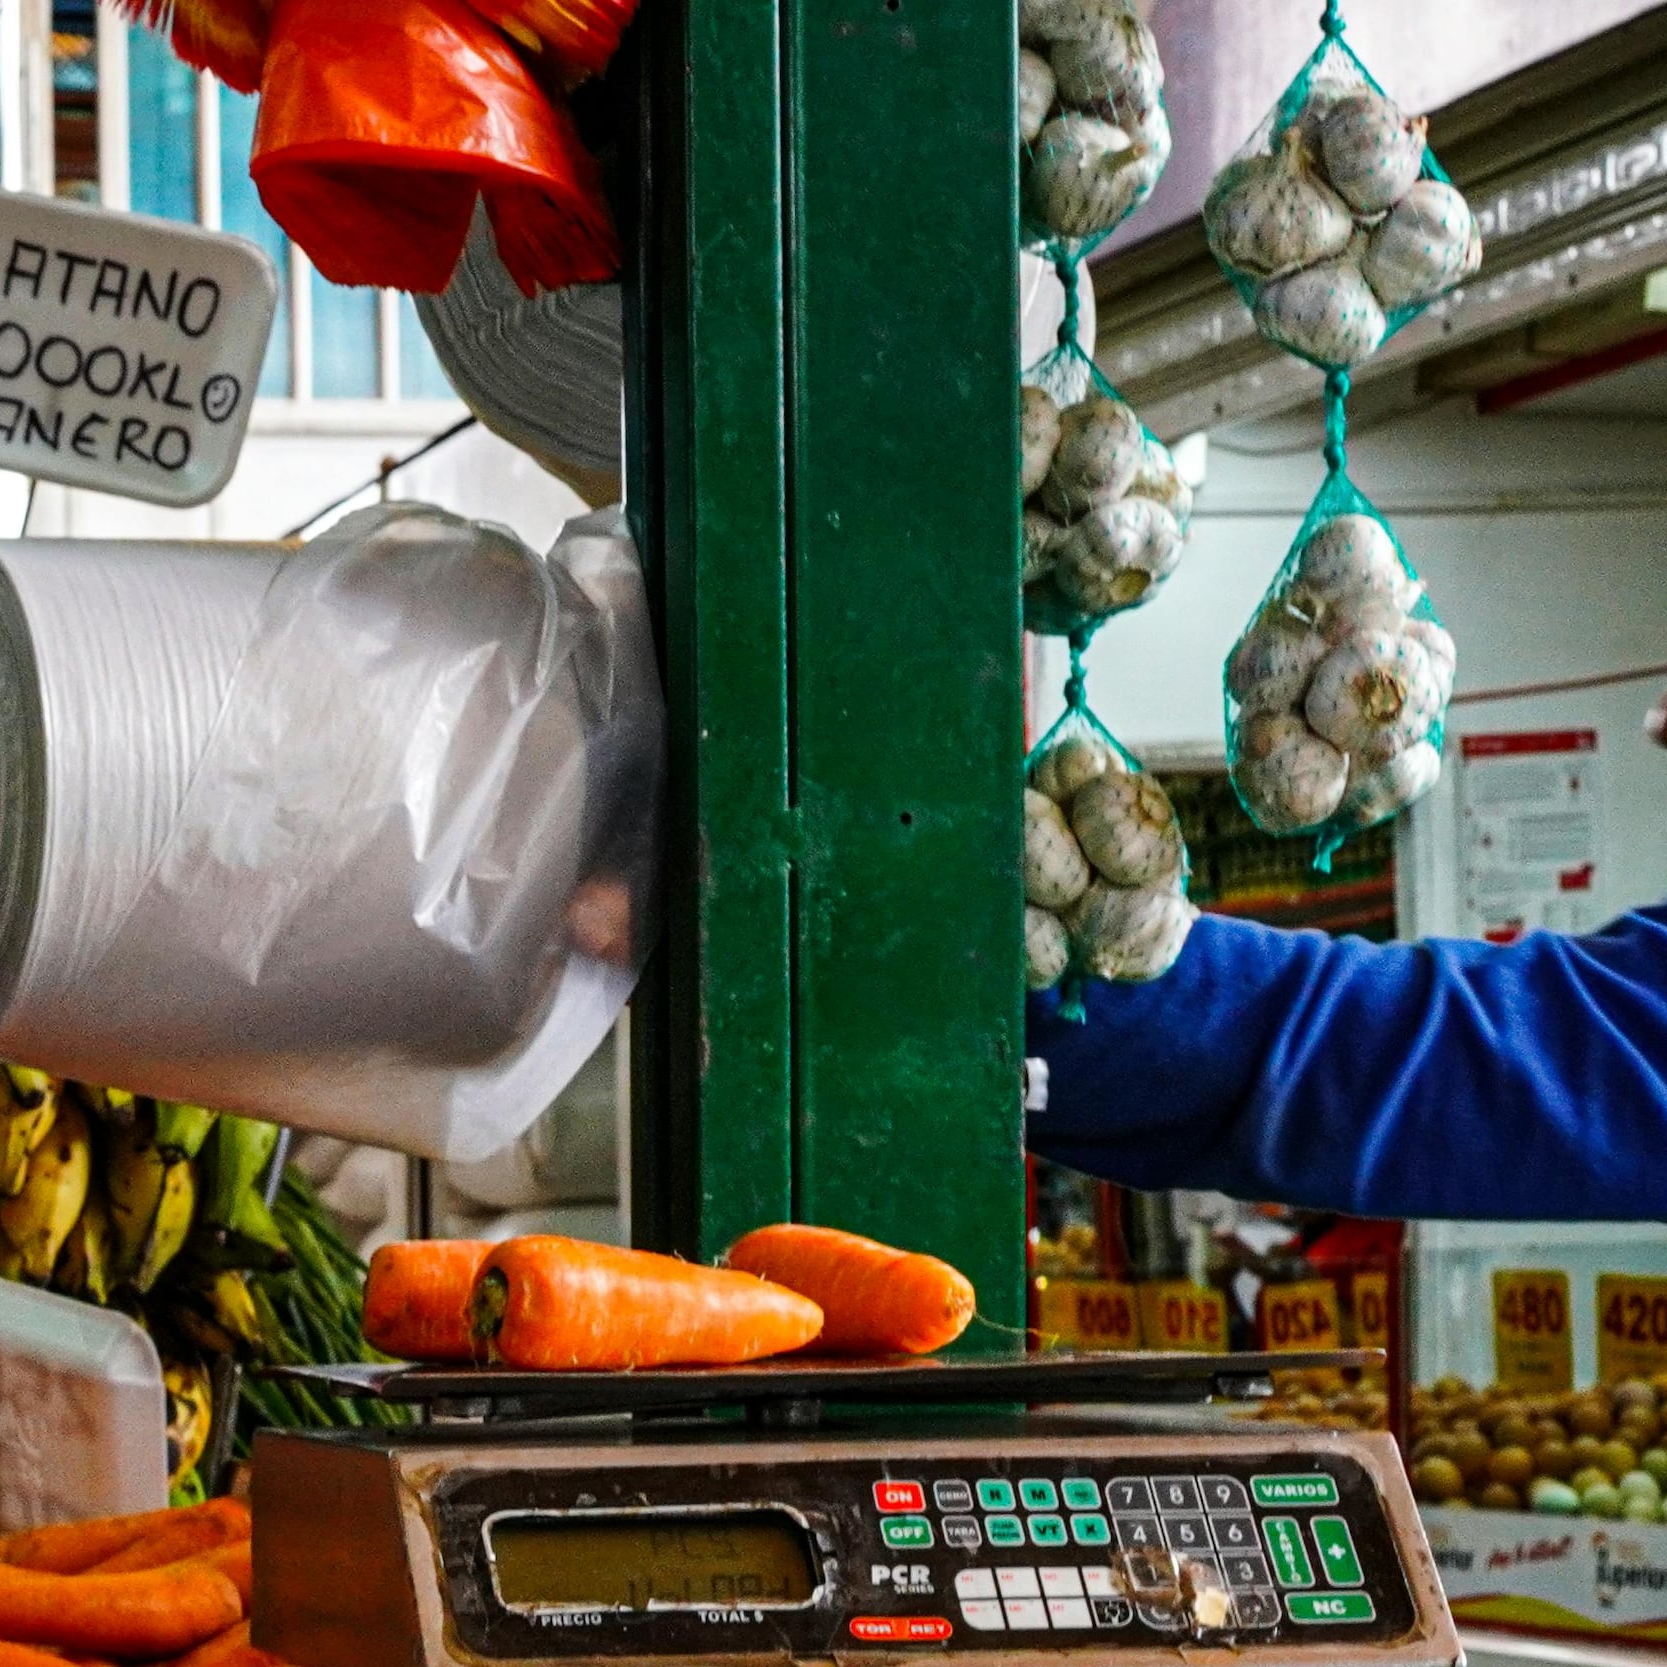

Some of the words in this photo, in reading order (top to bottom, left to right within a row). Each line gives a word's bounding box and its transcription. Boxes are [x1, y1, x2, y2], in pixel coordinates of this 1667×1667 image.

[885, 1489, 913, 1503] ON
[1121, 1485, 1133, 1504] 7
[1169, 1484, 1184, 1504] 8
[1216, 1484, 1231, 1504] 9
[1261, 1483, 1329, 1498] VARIOS
[889, 1526, 924, 1539] OFF
[1132, 1525, 1147, 1543] 4
[1179, 1523, 1195, 1543] 5
[1228, 1523, 1243, 1543] 6
[871, 1564, 931, 1586] PCR
[1239, 1561, 1254, 1581] 3
[1312, 1599, 1347, 1616] NC
[540, 1612, 603, 1627] PRECIO
[698, 1609, 750, 1624] TOTAL
